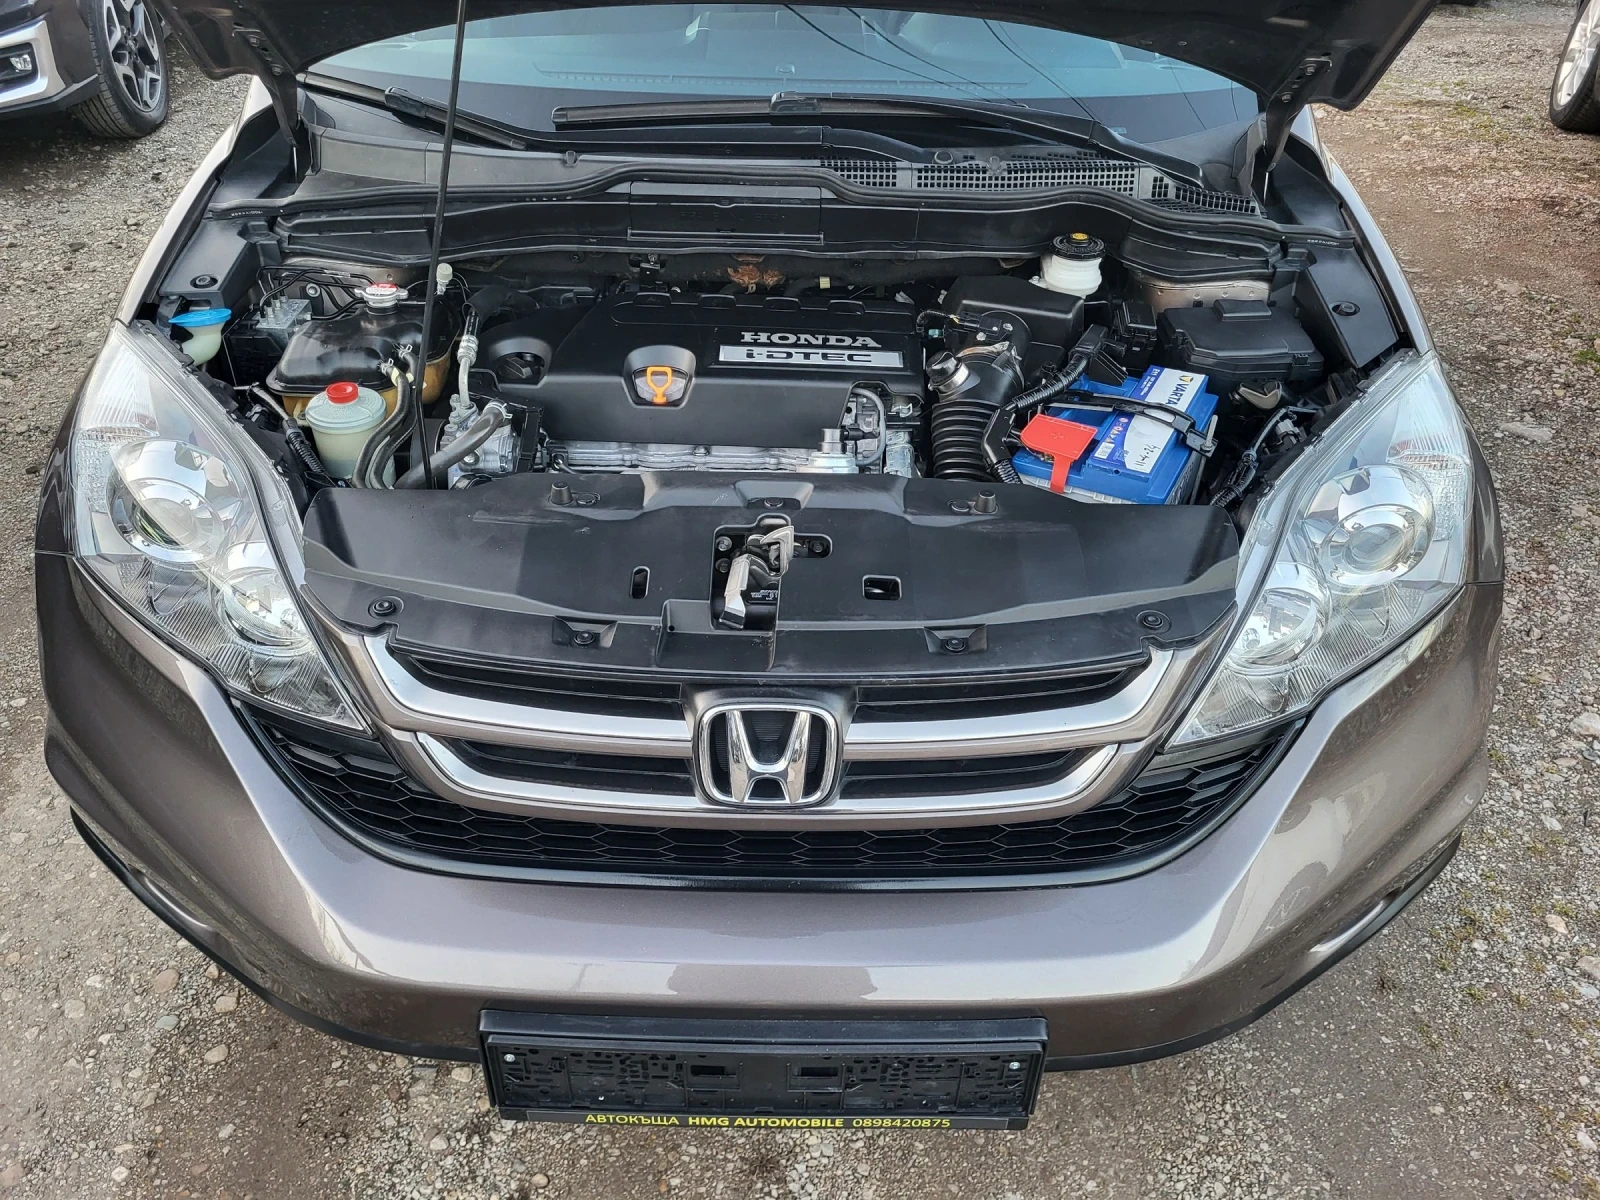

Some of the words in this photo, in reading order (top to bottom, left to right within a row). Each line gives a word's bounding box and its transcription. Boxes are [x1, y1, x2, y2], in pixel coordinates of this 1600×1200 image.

[740, 332, 882, 348] HONDA
[745, 348, 872, 363] i-DTEC
[1165, 383, 1190, 405] VARTA
[585, 1114, 680, 1127] АВТОКЪЩА
[688, 1116, 729, 1127] HMG
[734, 1117, 845, 1128] AUTOMOBILE
[852, 1118, 951, 1128] 0898420875
